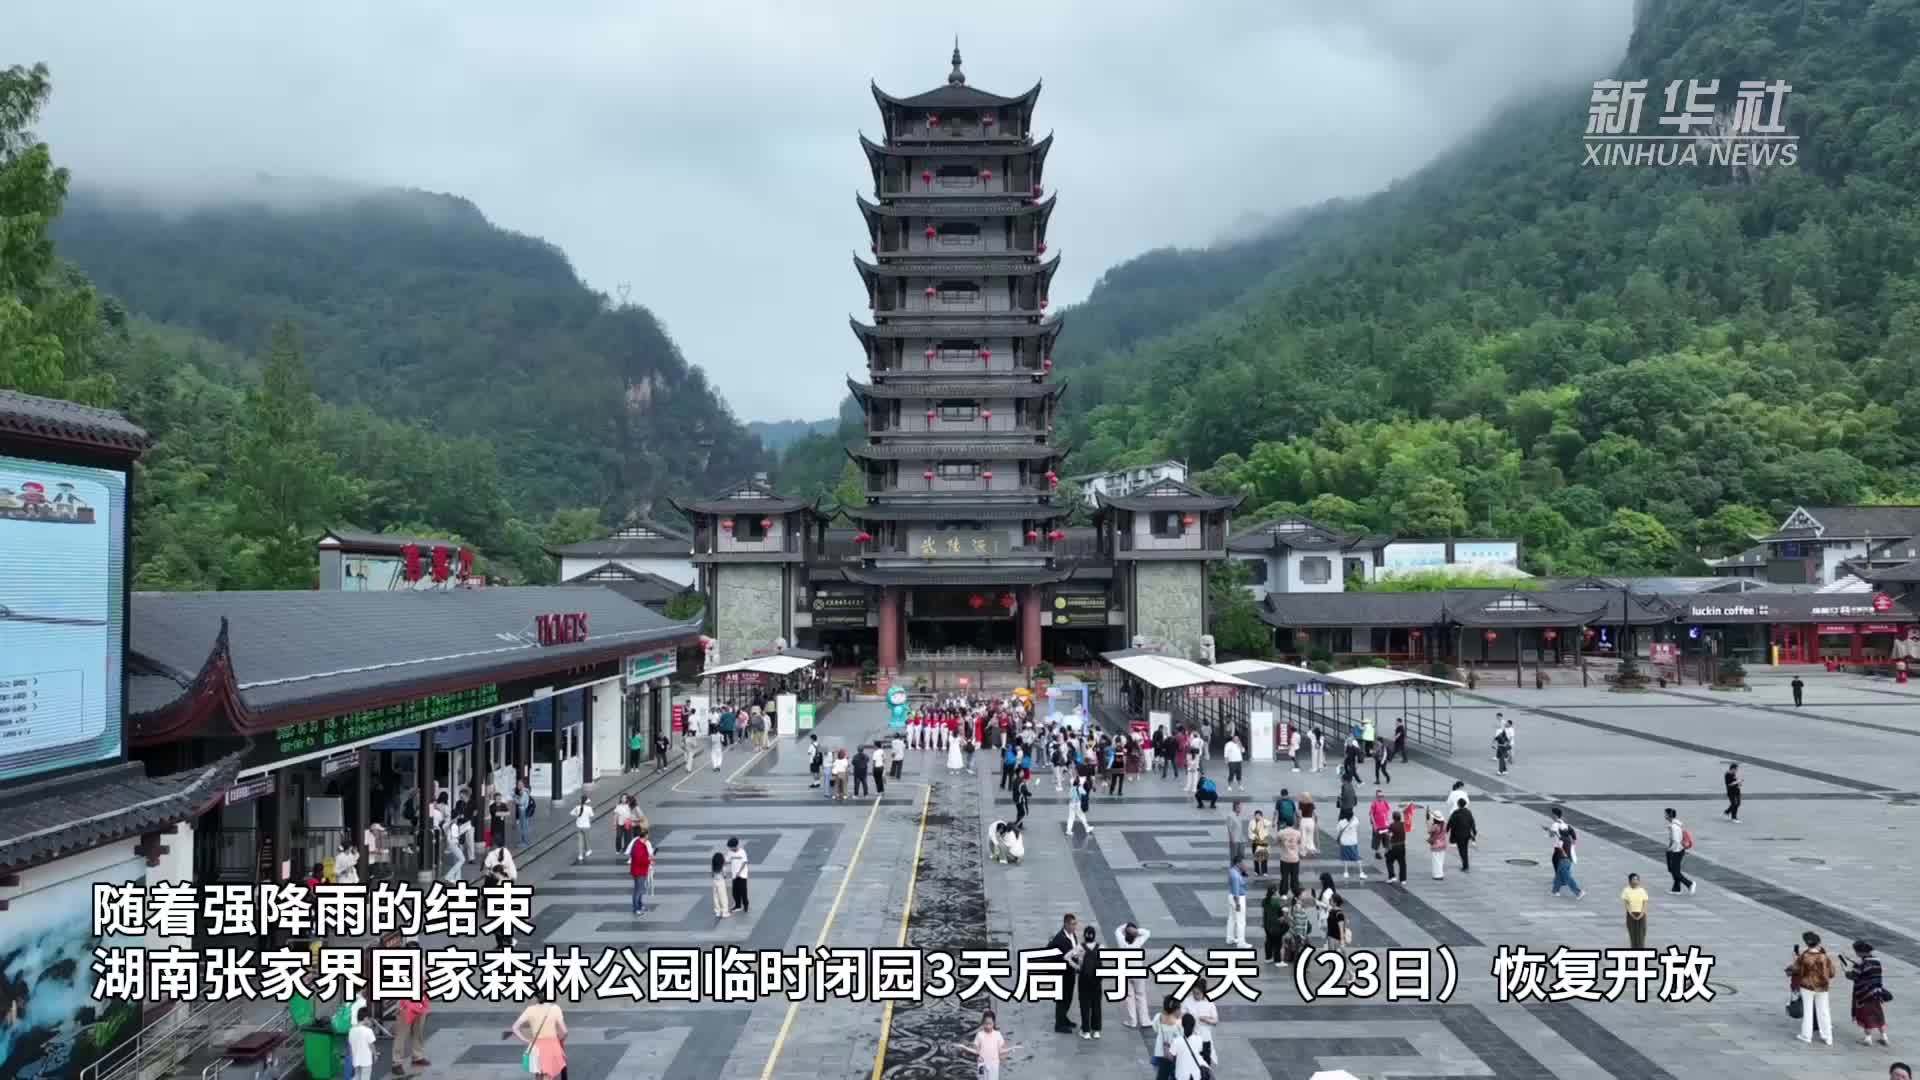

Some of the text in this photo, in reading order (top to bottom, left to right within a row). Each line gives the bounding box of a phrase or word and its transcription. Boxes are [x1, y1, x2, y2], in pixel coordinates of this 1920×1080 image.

[1692, 605, 1722, 616] luckin
[1723, 605, 1755, 616] coffee
[535, 612, 588, 647] TICKETS
